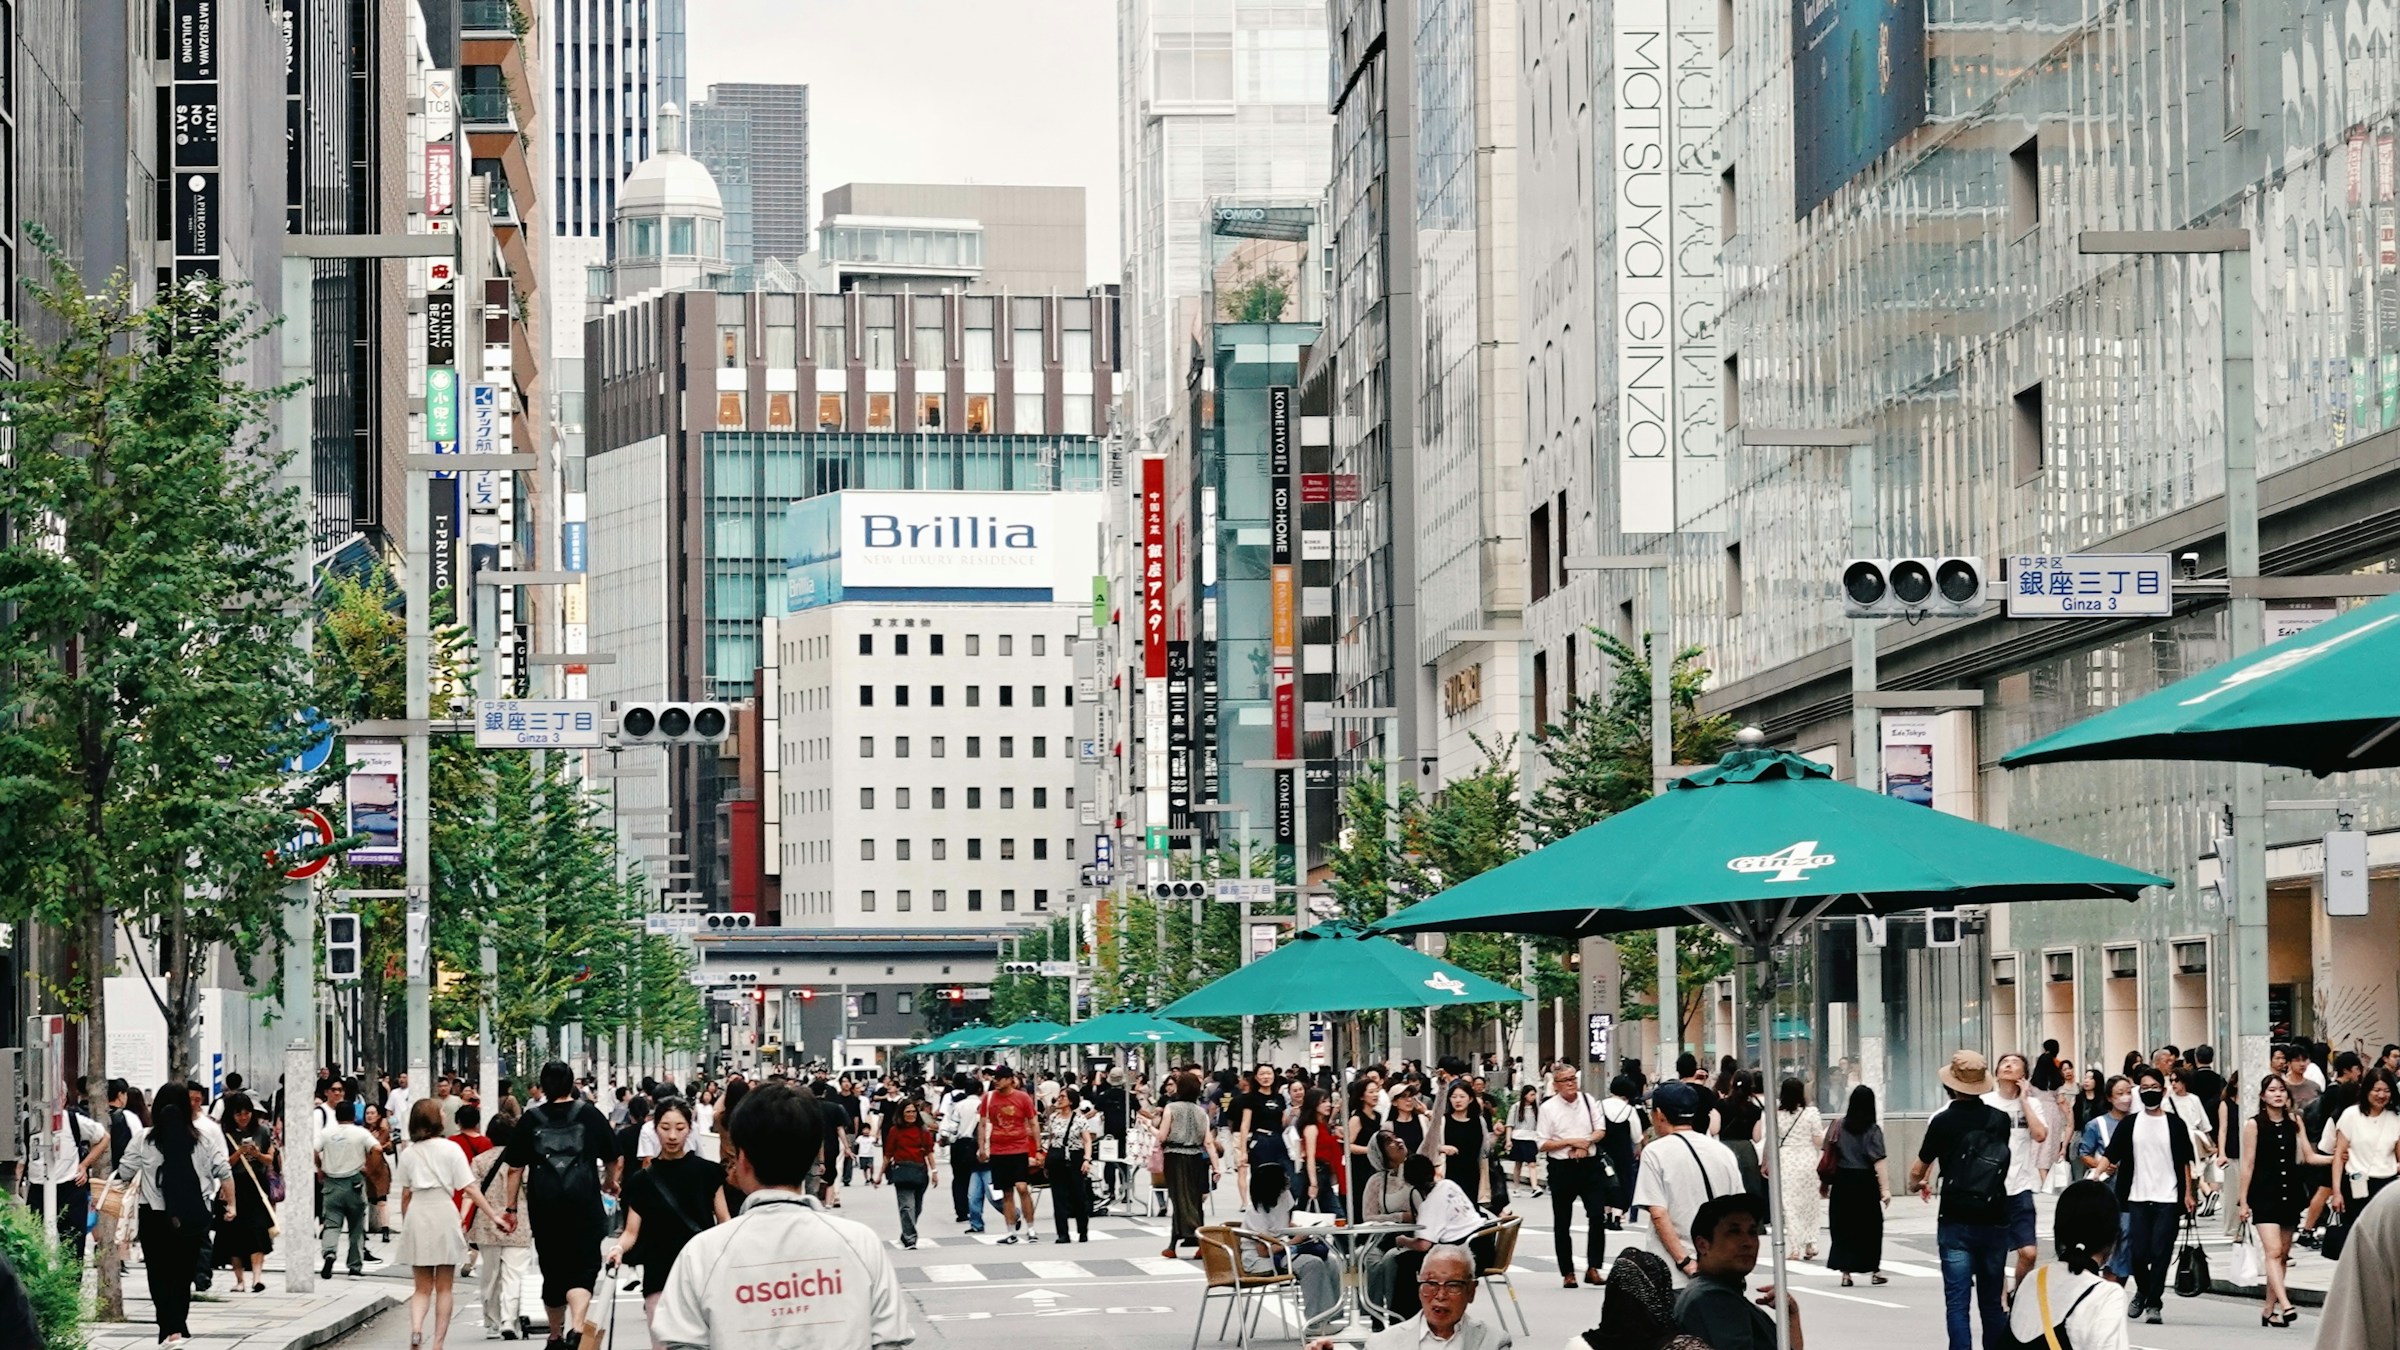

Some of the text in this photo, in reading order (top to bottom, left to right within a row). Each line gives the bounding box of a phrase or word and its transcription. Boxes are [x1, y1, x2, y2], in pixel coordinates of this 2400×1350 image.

[182, 15, 192, 64] BUILDING
[199, 2, 209, 76] MATSUZAWA 5
[191, 105, 202, 126] NO
[205, 105, 217, 134] FUJI
[428, 101, 451, 113] TCB
[429, 155, 439, 212] ゴルフスクール
[197, 194, 206, 254] APHRODITE
[1216, 208, 1265, 220] YOMIKO
[429, 303, 440, 349] BEAUTY
[441, 302, 452, 349] CLINIC
[1274, 391, 1285, 453] KOMEHYO
[476, 407, 493, 504] テック航ービス
[860, 515, 1038, 549] Brillia
[435, 514, 449, 590] I-PRIMO
[863, 554, 1036, 566] NEW LUXURY RESIDENCE
[2019, 556, 2063, 569] 中央区
[1147, 544, 1163, 646] 銀座アスター
[2019, 571, 2160, 596] 銀座三丁目
[2062, 597, 2117, 611] Ginza 3
[484, 702, 519, 711] 中央区
[484, 712, 593, 731] 銀座三丁目
[517, 733, 560, 744] Ginza 3
[1279, 774, 1290, 838] KOMEHYO
[1731, 856, 1832, 869] Ginza
[735, 1268, 842, 1304] asaichi
[771, 1304, 810, 1317] STAFF
